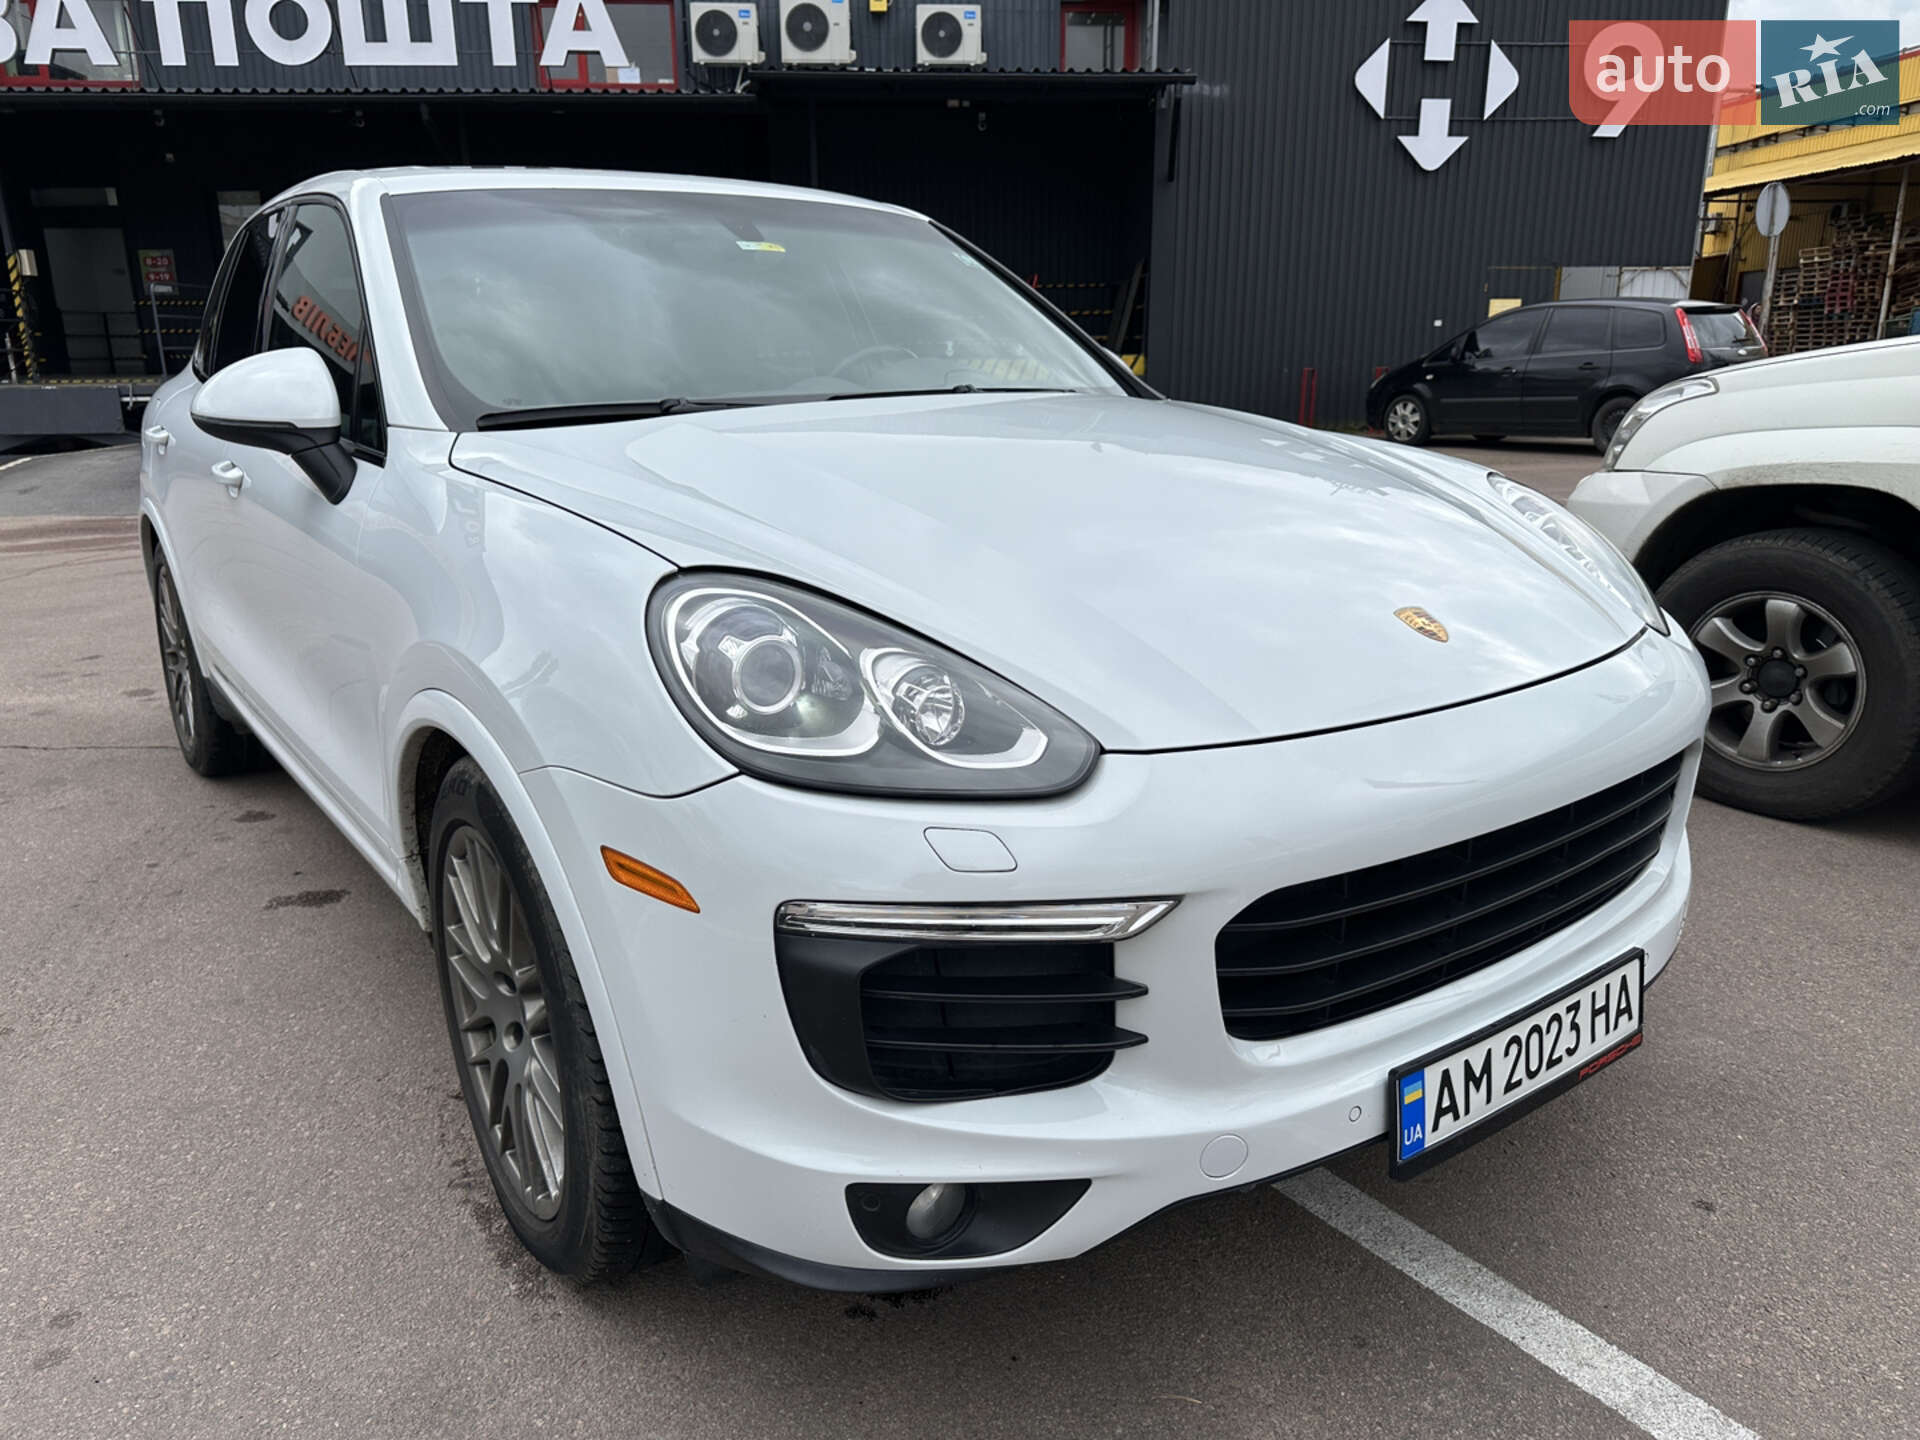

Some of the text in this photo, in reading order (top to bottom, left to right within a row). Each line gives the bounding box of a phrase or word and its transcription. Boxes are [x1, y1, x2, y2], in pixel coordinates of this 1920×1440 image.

[141, 0, 631, 67] ПОШТА
[1431, 974, 1634, 1133] AM 2023 HA
[1404, 1122, 1423, 1146] UA
